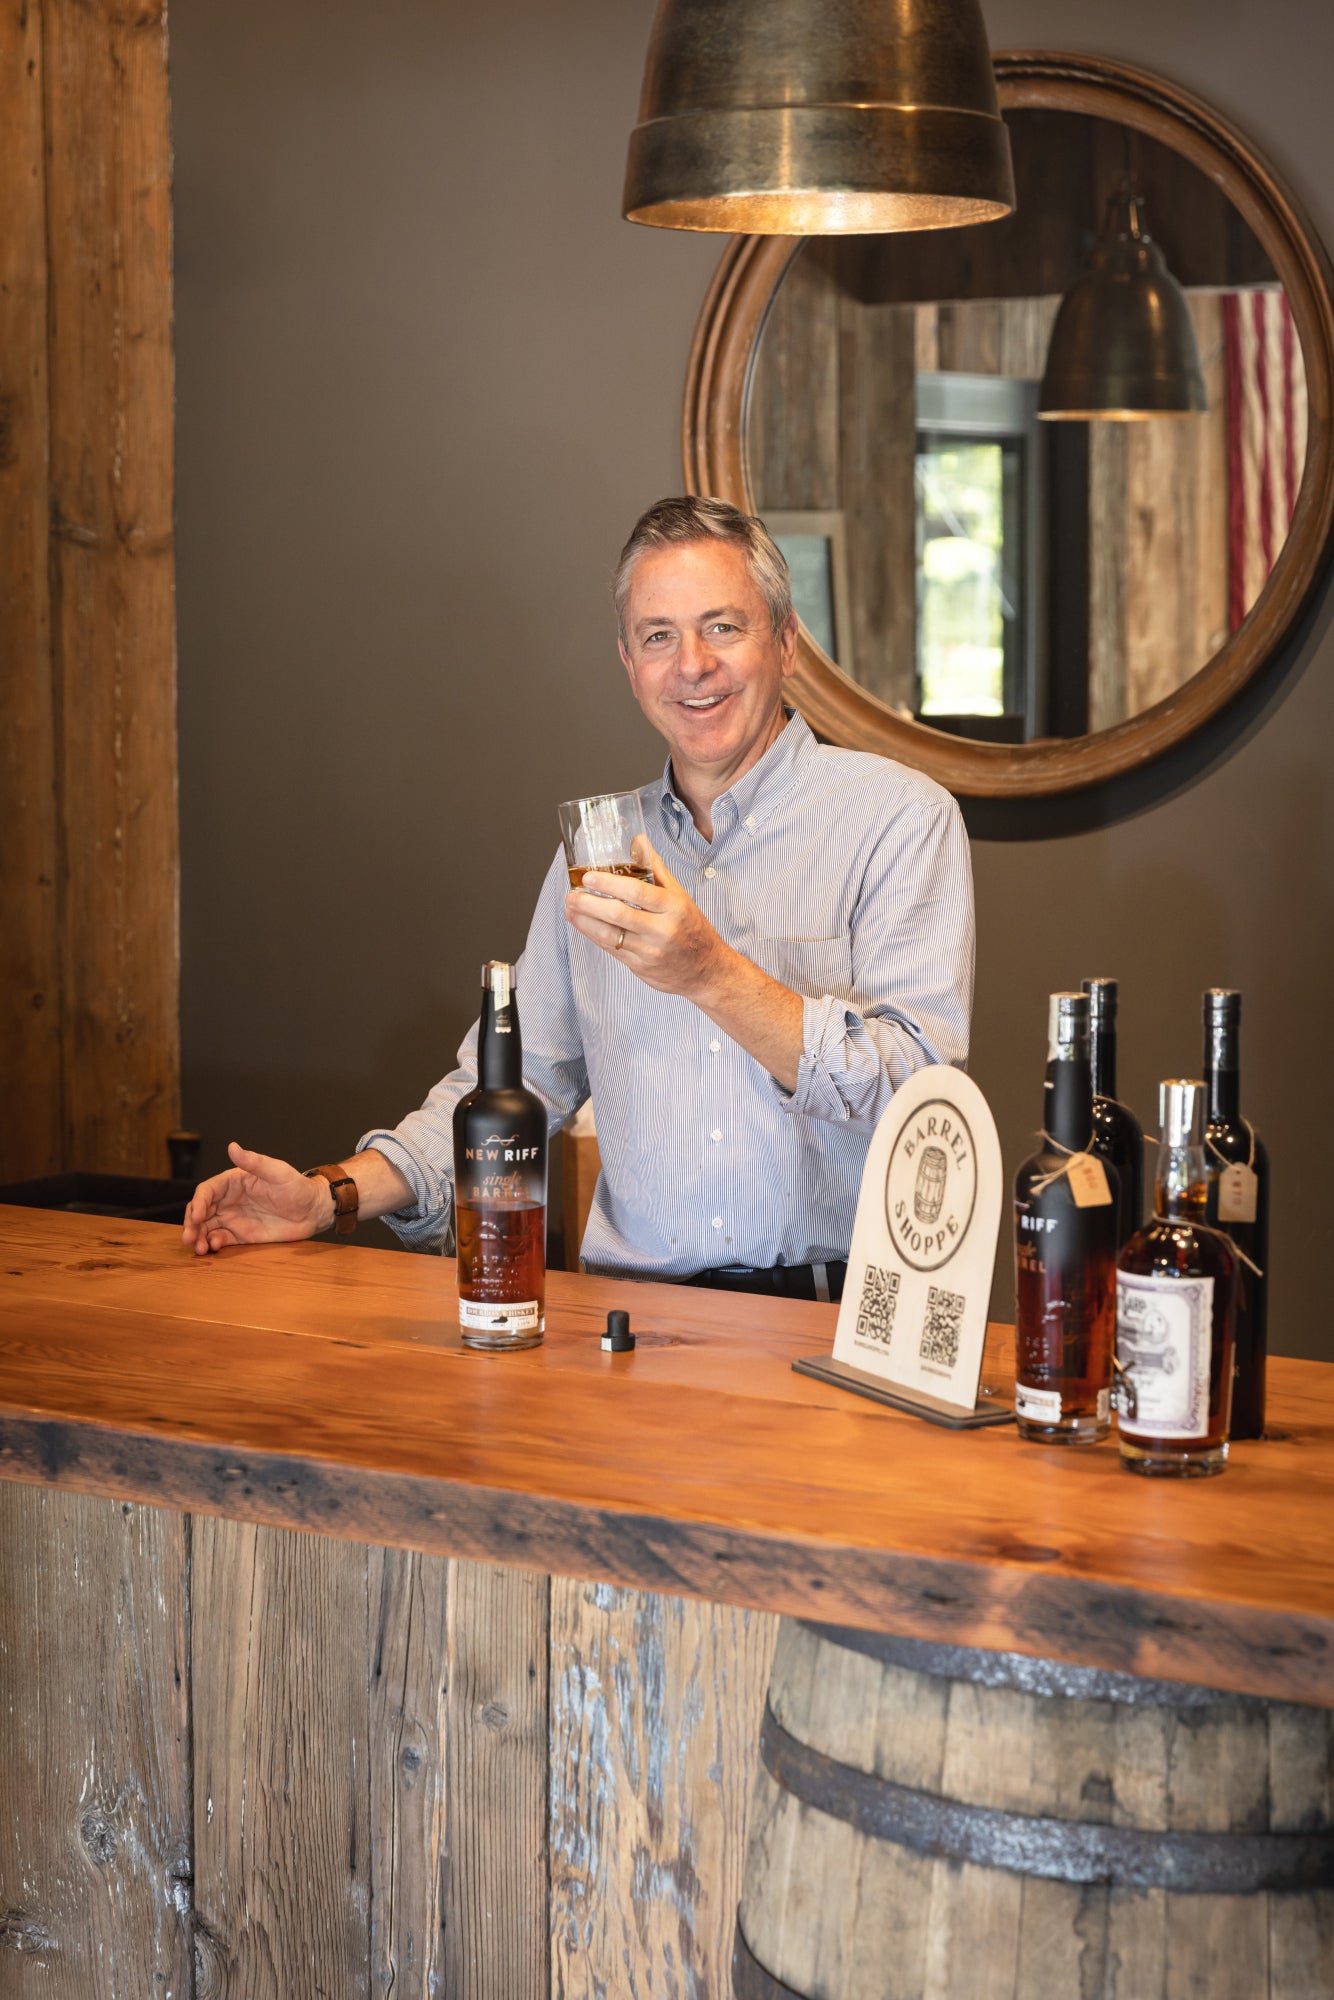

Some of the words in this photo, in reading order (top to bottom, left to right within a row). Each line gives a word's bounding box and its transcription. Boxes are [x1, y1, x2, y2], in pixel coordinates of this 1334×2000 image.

[903, 1116, 968, 1171] BARREL
[465, 1147, 499, 1161] NEW
[504, 1147, 539, 1161] RIFF
[482, 1171, 523, 1188] single
[472, 1185, 530, 1199] BARREL
[895, 1200, 959, 1256] SHOPPE
[1021, 1214, 1059, 1233] RIFF
